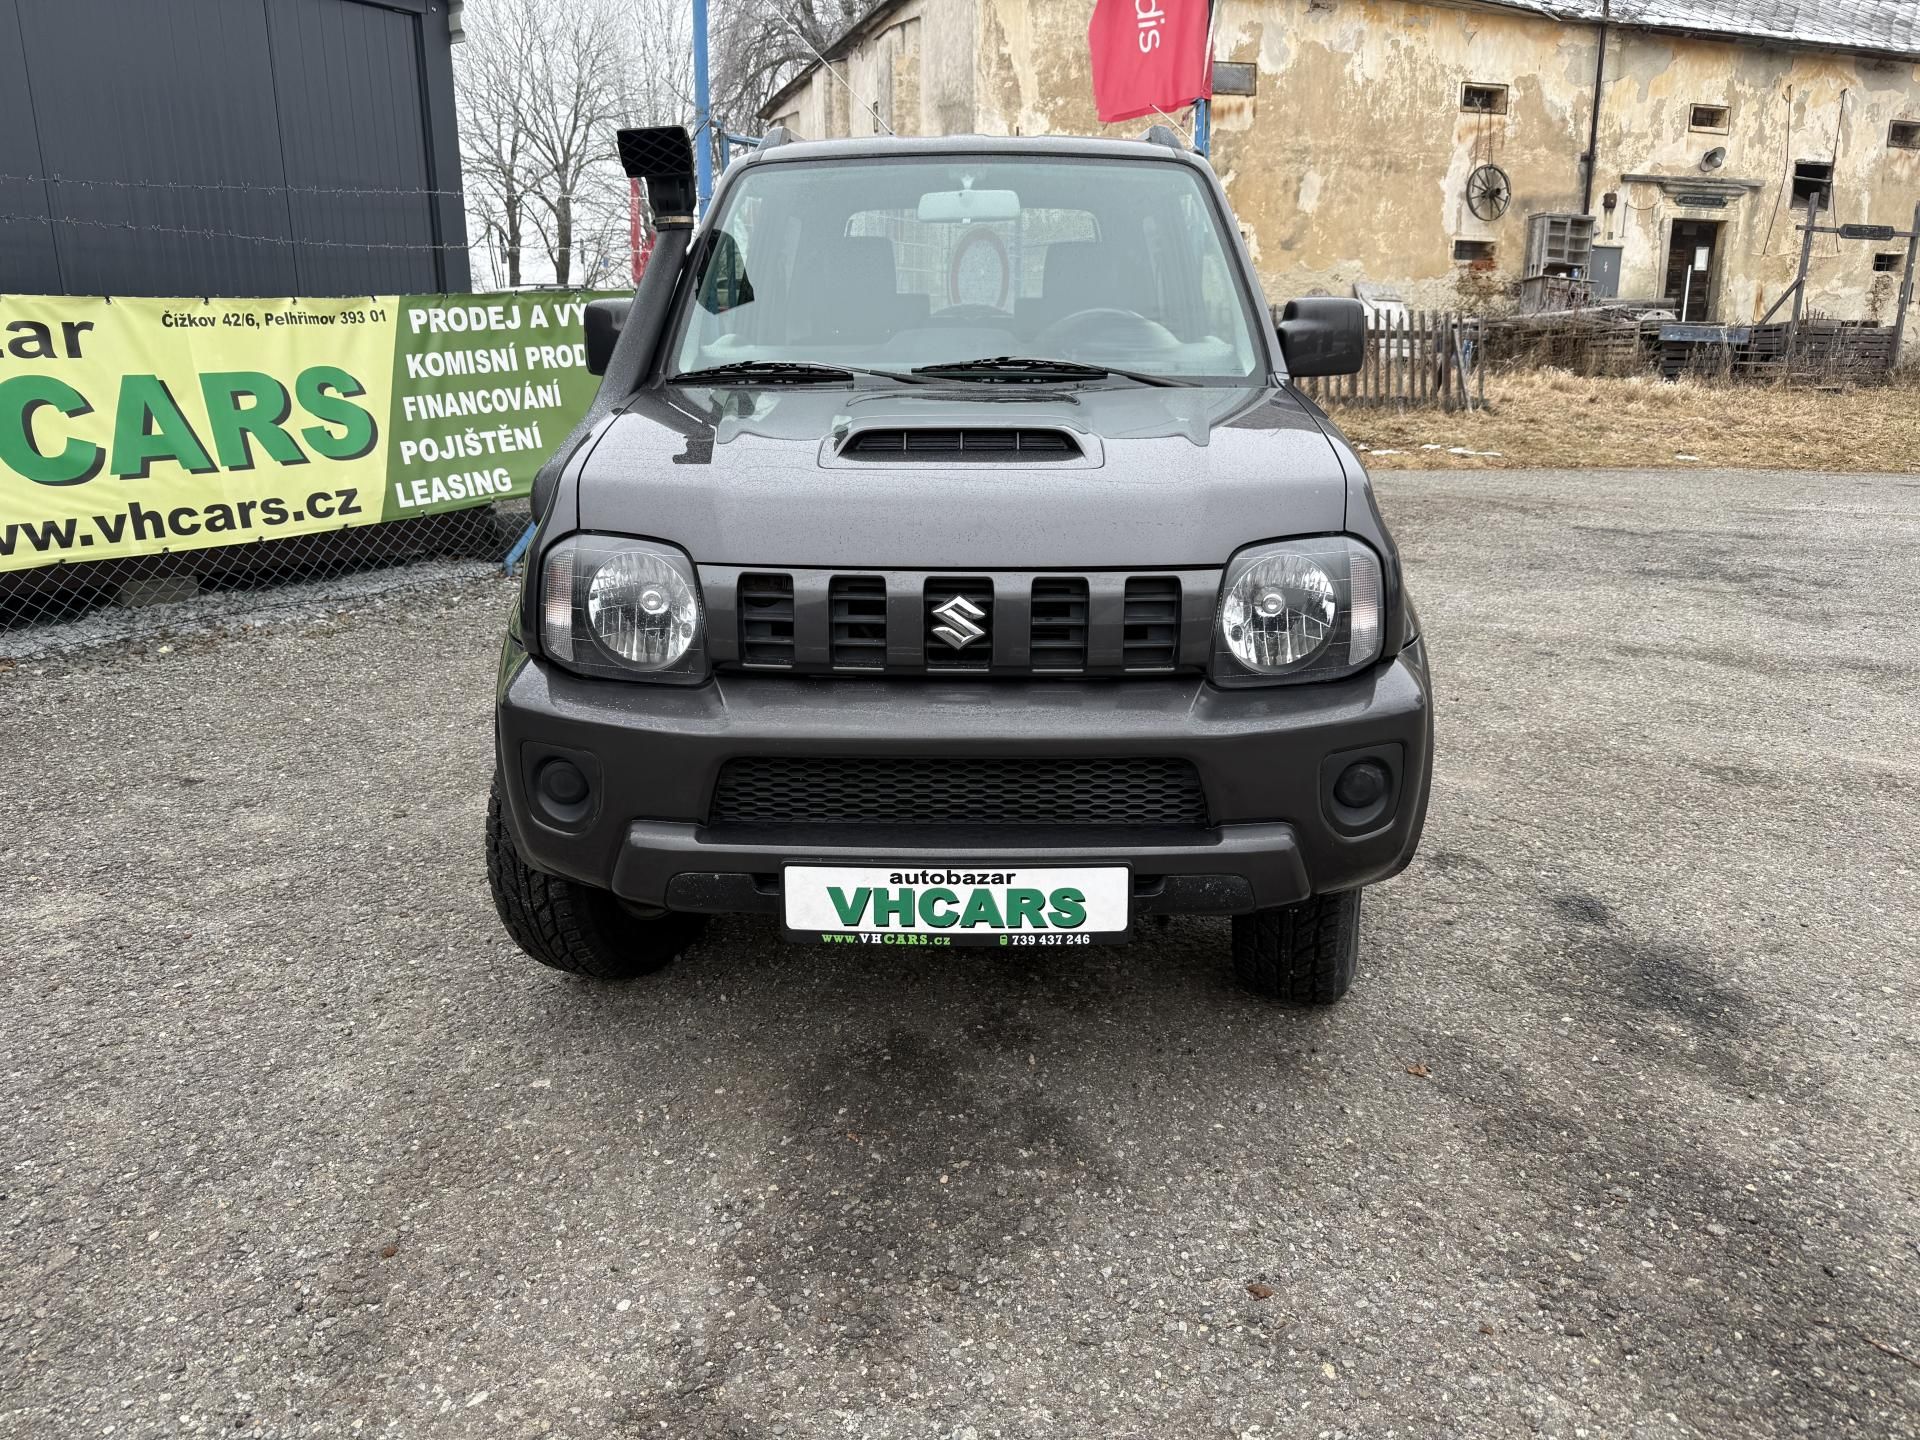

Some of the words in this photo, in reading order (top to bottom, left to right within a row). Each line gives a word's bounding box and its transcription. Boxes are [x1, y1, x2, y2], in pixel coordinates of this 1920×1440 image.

[161, 310, 216, 328] Čížkov
[222, 313, 260, 329] 42/6,
[265, 312, 336, 326] Pelhřimov
[340, 311, 366, 324] 393
[370, 309, 387, 322] 01
[408, 305, 521, 334] PRODEJ
[530, 304, 549, 328] A
[553, 297, 587, 327] VÝ
[0, 320, 95, 359] ar
[405, 342, 519, 379] KOMISNÍ
[525, 343, 586, 370] PROD
[402, 379, 562, 421] FINANCOVÁNÍ
[0, 365, 379, 486] CARS
[400, 421, 543, 465] POJIŠTĚNÍ
[395, 467, 513, 508] LEASING
[889, 870, 1016, 885] autobazar
[826, 887, 1087, 928] VHCARS
[821, 933, 951, 946] www.VHCARS.cz
[1012, 935, 1036, 946] 739
[1039, 934, 1063, 946] 437
[1066, 934, 1090, 945] 246
